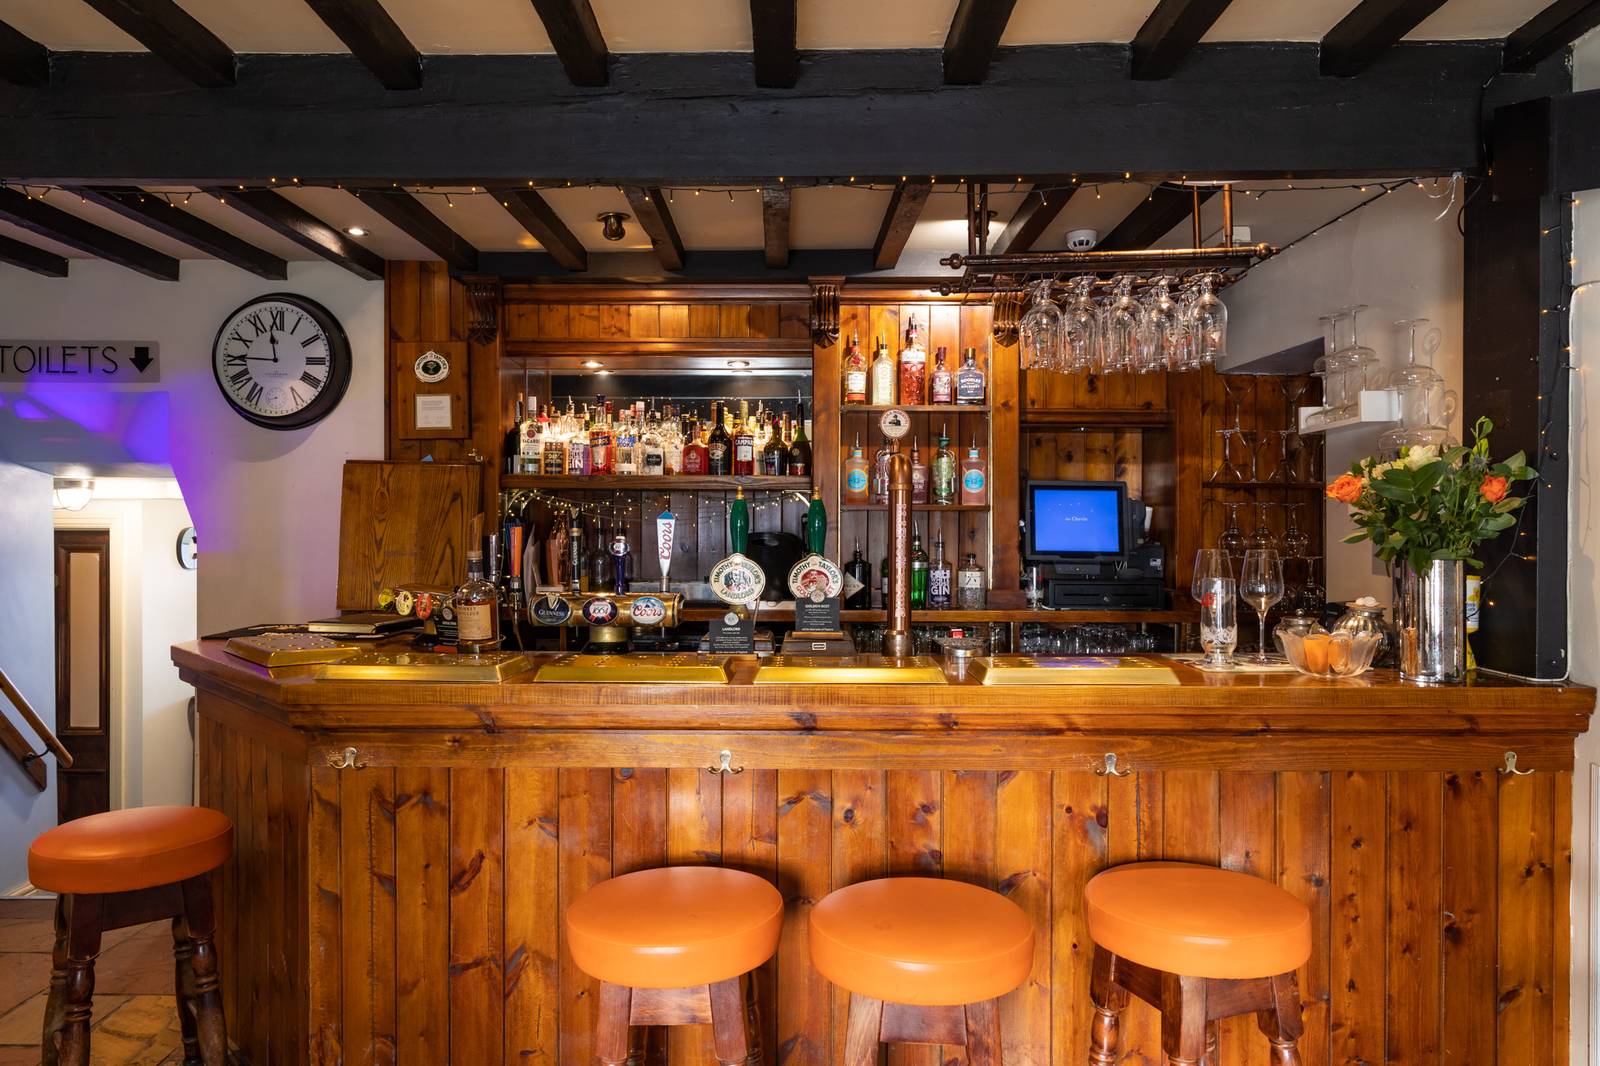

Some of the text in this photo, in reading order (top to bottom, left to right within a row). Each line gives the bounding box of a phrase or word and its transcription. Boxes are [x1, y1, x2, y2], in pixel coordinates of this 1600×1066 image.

[247, 314, 267, 337] XI
[290, 316, 302, 335] I
[231, 330, 253, 349] X
[301, 333, 321, 348] II
[0, 346, 118, 374] TOILETS
[305, 357, 327, 366] III
[660, 522, 672, 560] Coors
[714, 561, 733, 583] TIMOTHY
[792, 562, 840, 584] TIMOTHY TAYLOR'S
[721, 588, 755, 600] LANDLORD
[931, 586, 950, 596] GIN
[538, 608, 567, 617] GUINNESS
[592, 606, 609, 614] 1664
[632, 604, 663, 617] Coors
